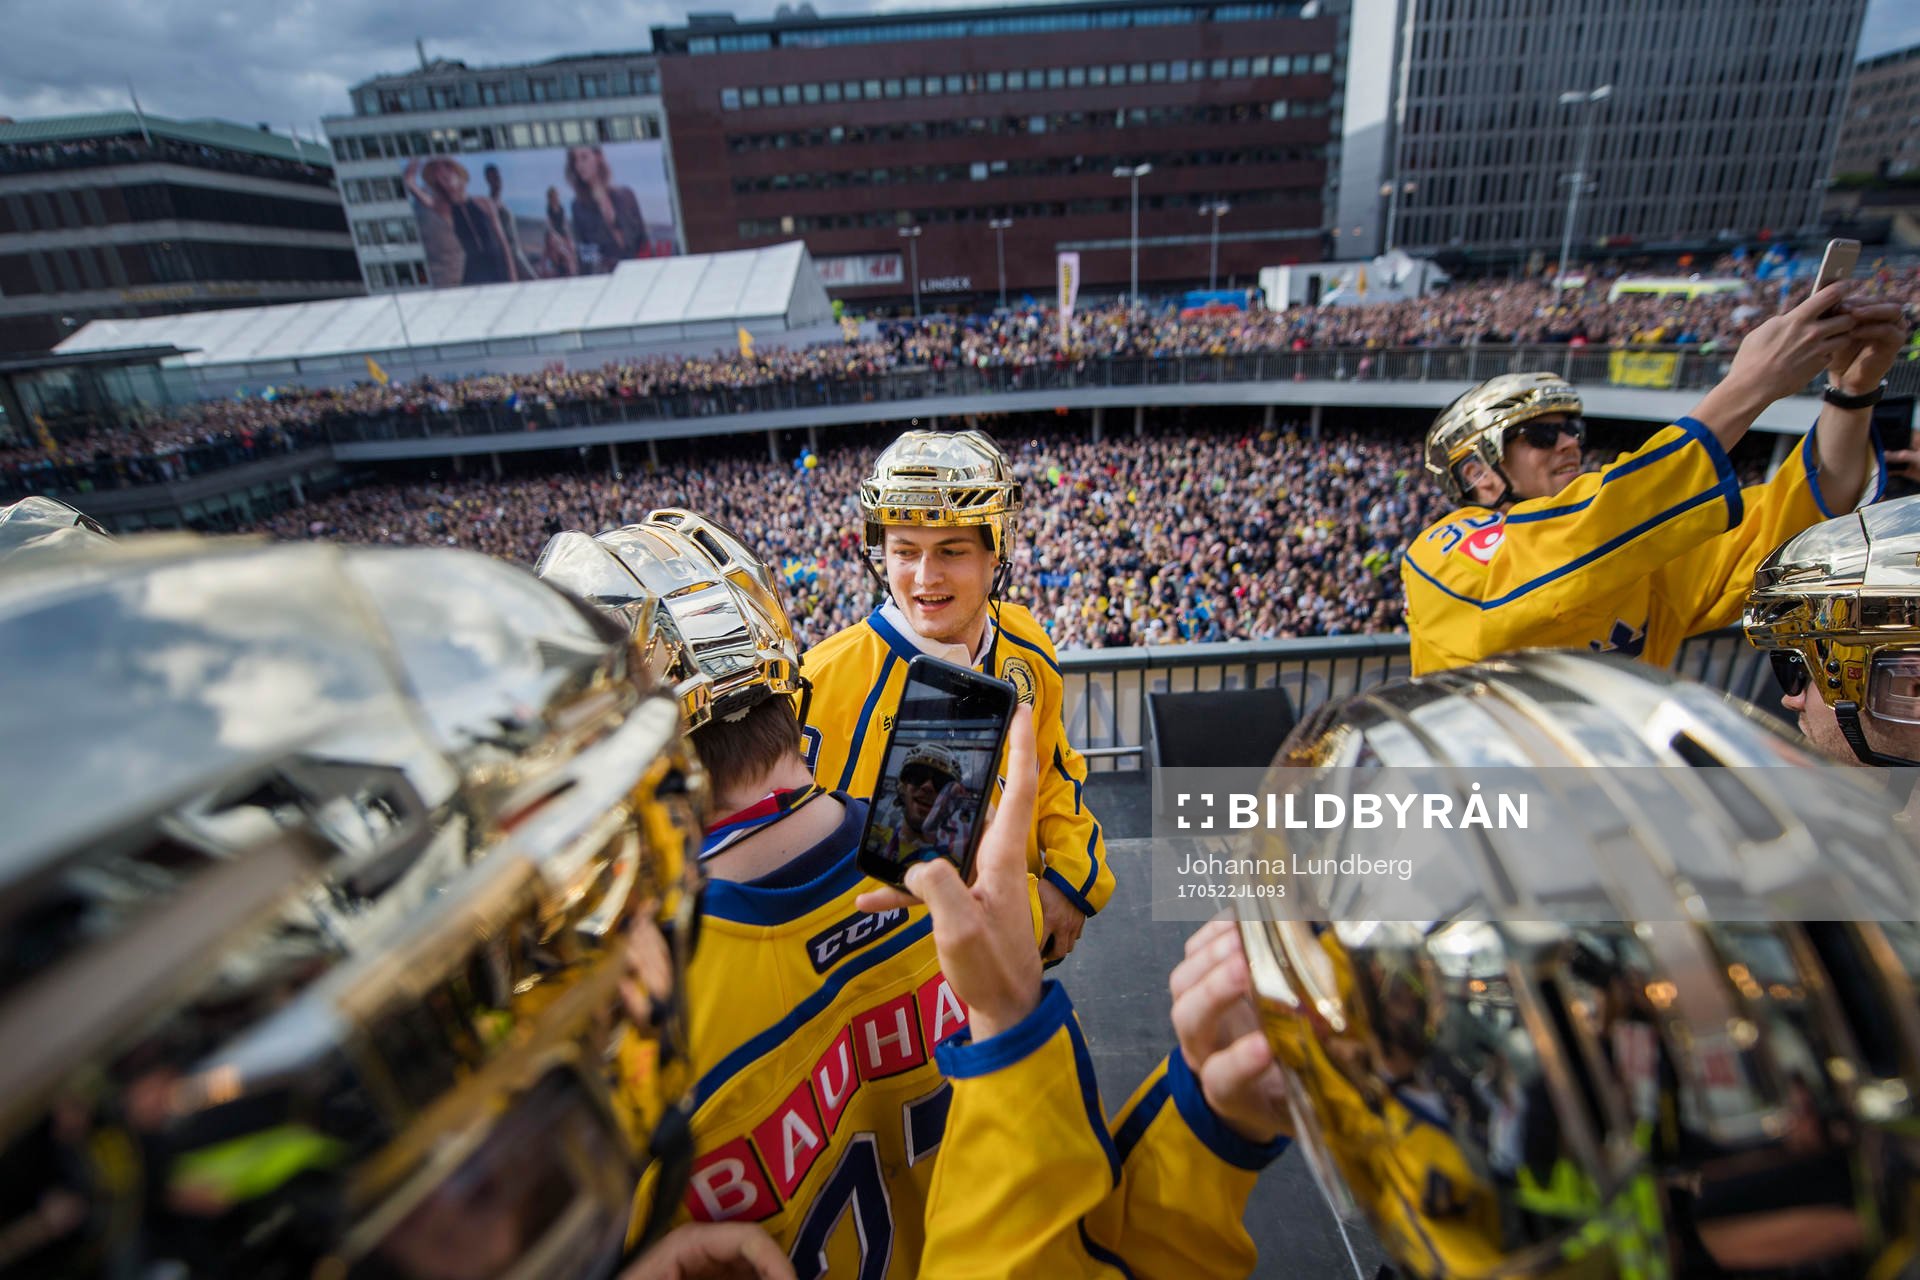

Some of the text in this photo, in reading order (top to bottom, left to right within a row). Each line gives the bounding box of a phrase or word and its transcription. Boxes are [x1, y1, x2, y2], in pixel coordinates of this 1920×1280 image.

[920, 277, 972, 292] LINDEX
[815, 908, 900, 964] CCM
[690, 979, 966, 1221] BAUHA
